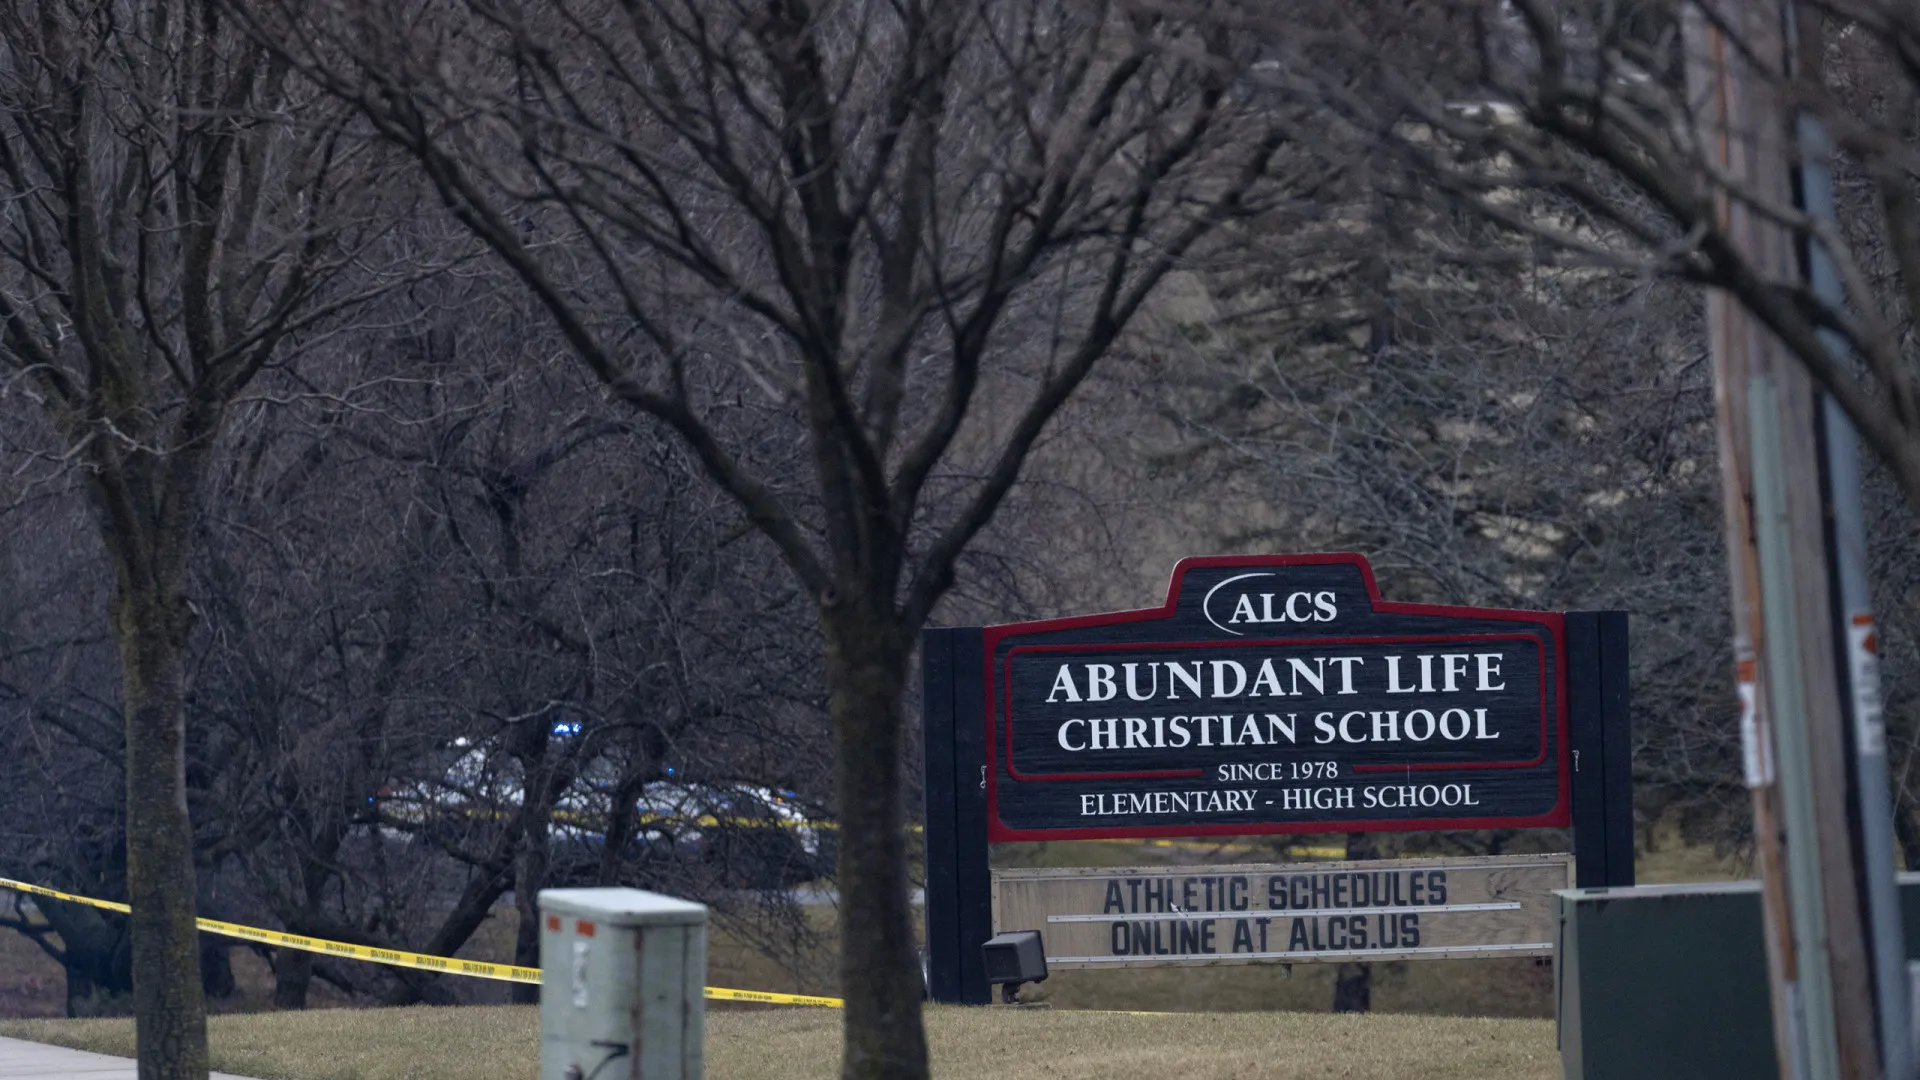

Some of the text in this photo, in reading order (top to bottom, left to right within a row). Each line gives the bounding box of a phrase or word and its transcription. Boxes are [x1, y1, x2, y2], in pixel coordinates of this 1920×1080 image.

[1229, 592, 1337, 624] ALCS
[1046, 653, 1506, 703] ABUNDANT LIFE
[1058, 709, 1499, 751] CHRISTIAN SCHOOL
[1218, 762, 1338, 782] SINCE 1978
[1081, 790, 1257, 815] ELEMENTARY
[1283, 788, 1355, 810] HIGH
[1363, 785, 1479, 808] SCHOOL
[1104, 871, 1447, 914] ATHLETIC SCHEDULES
[1112, 915, 1420, 955] ONLINE AT ALCS.US
